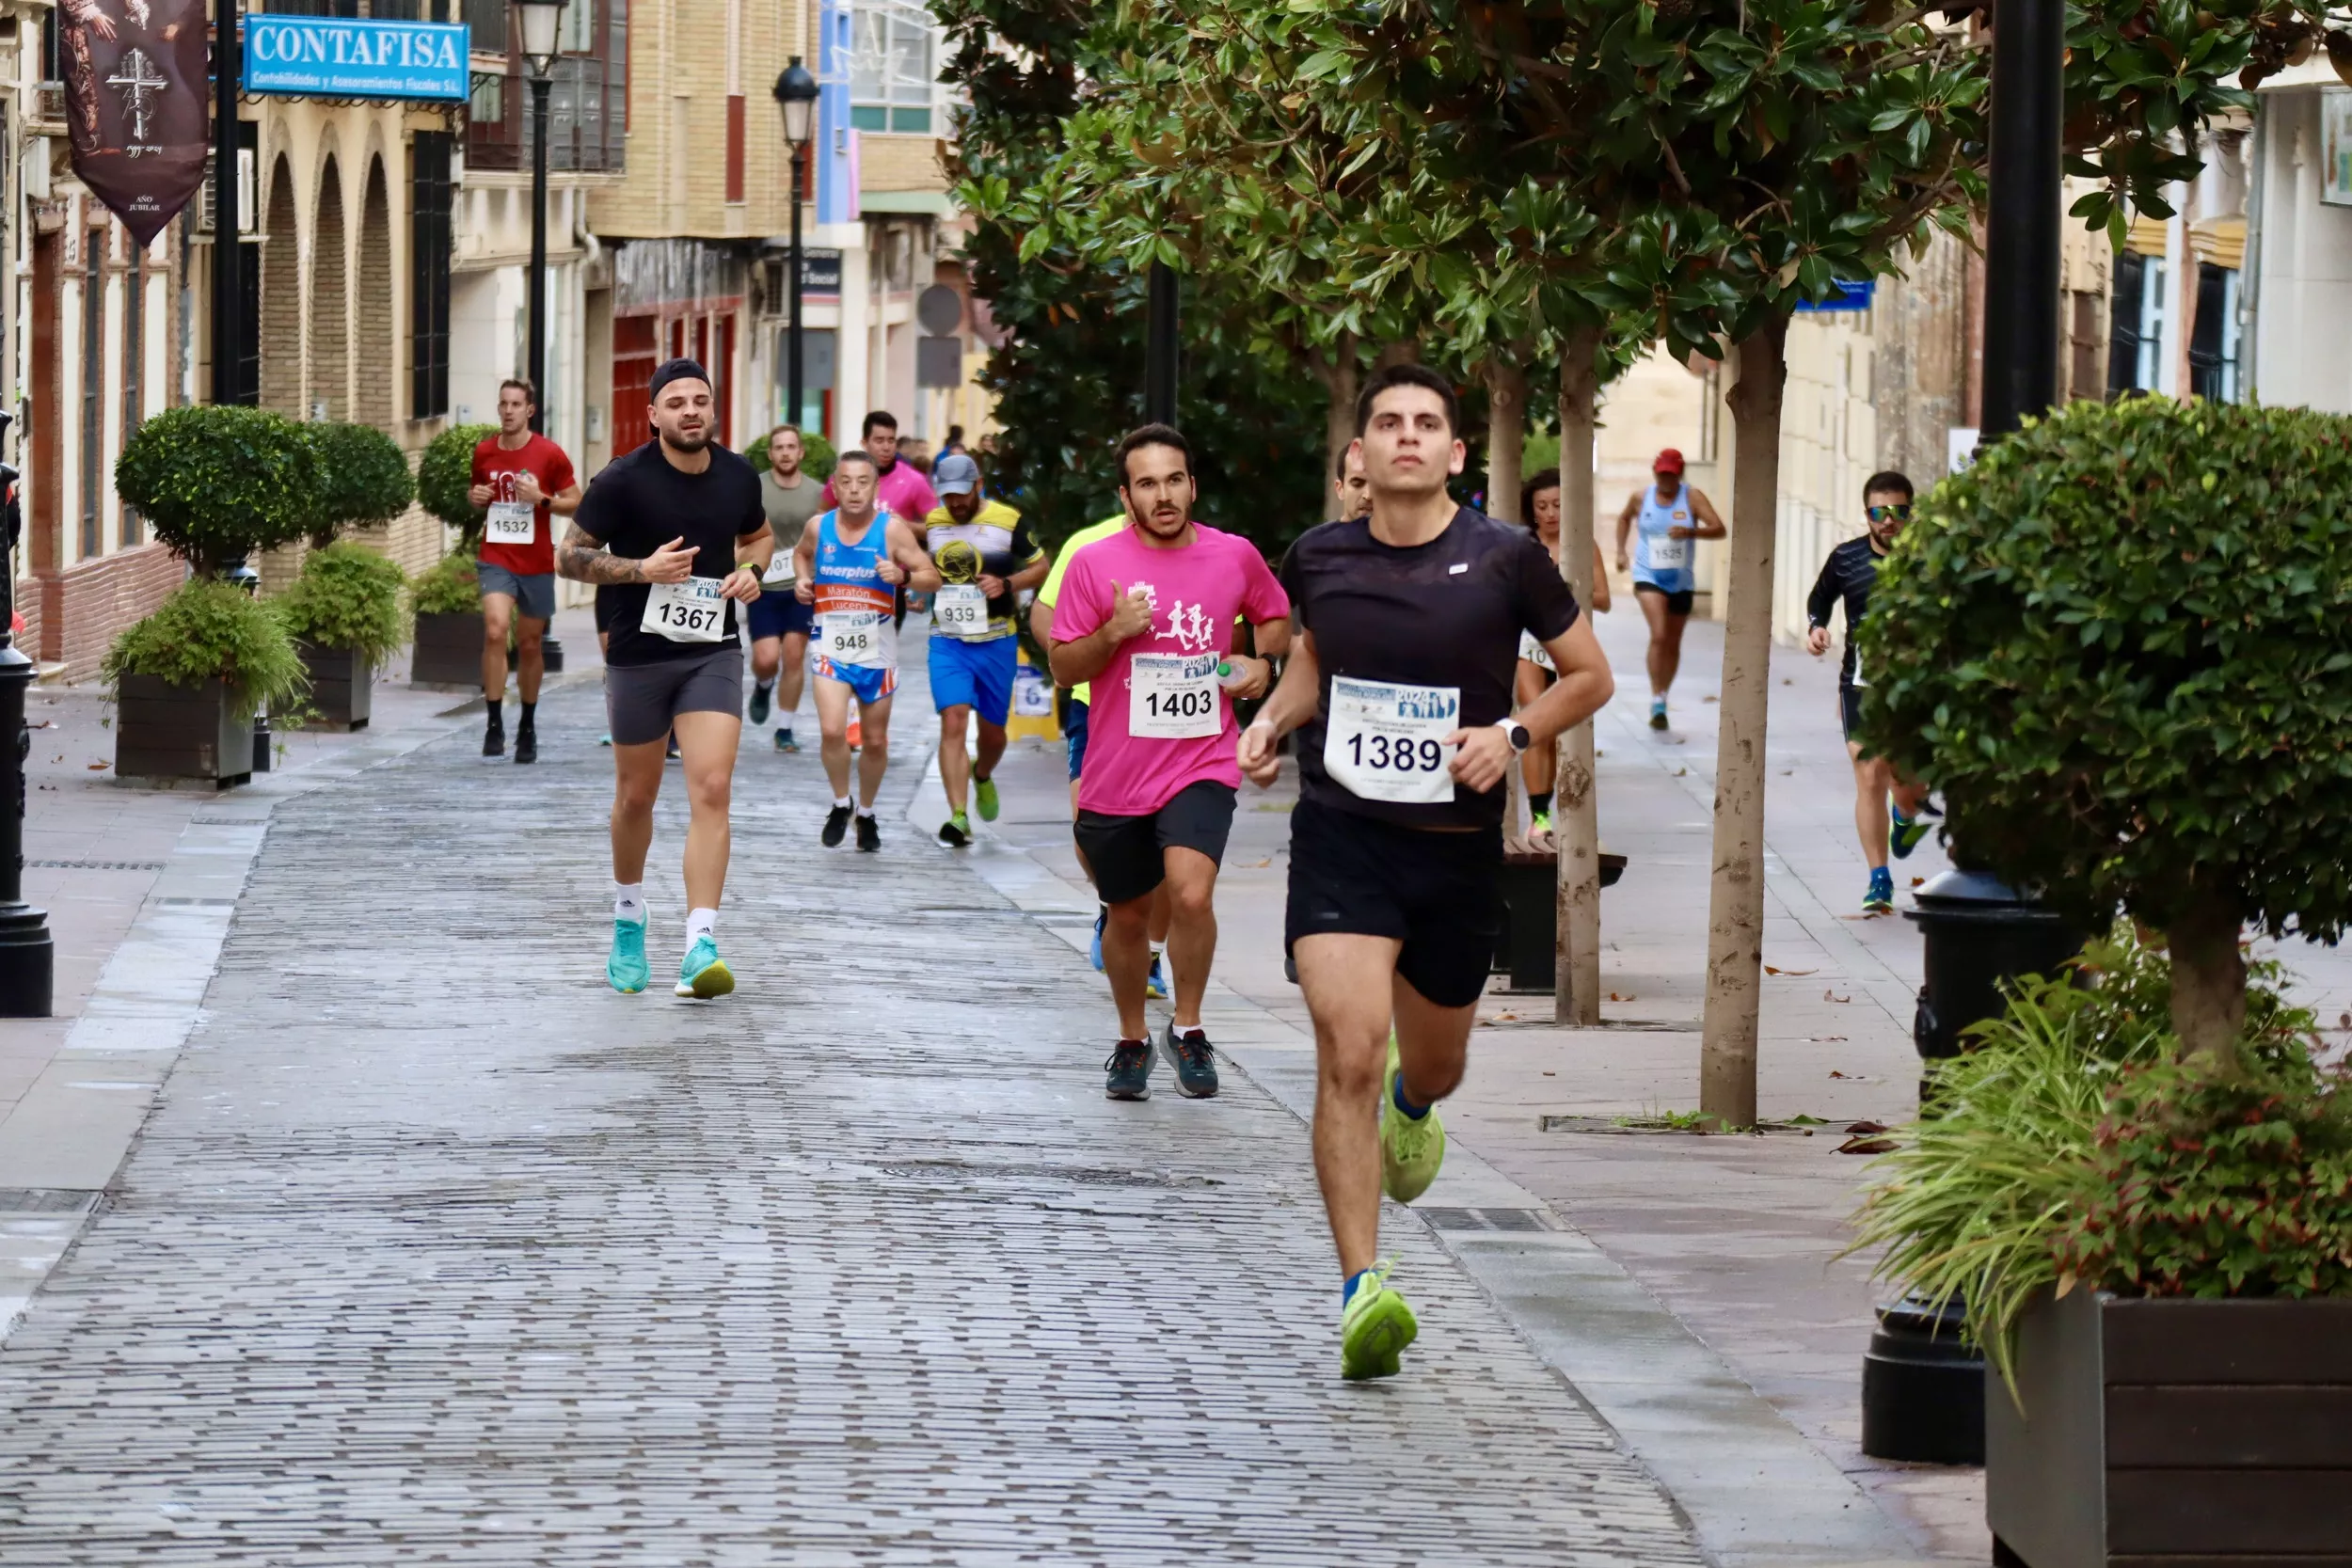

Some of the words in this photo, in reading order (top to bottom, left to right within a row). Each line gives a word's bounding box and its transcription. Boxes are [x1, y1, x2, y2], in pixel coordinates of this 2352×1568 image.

[253, 25, 459, 69] CONTAFISA
[252, 71, 320, 86] Contabilidades
[322, 77, 328, 89] y
[331, 74, 404, 89] Asesoramientos
[405, 77, 441, 91] Fiscales
[808, 273, 837, 284] Social
[494, 519, 529, 533] 1532
[770, 556, 789, 572] 07
[819, 565, 876, 579] enerplus
[827, 586, 871, 599] Maratón
[831, 600, 869, 611] Lucena
[659, 603, 718, 632] 1367
[944, 607, 975, 622] 939
[834, 634, 867, 651] 948
[1146, 689, 1212, 718] 1403
[1347, 733, 1441, 772] 1389
